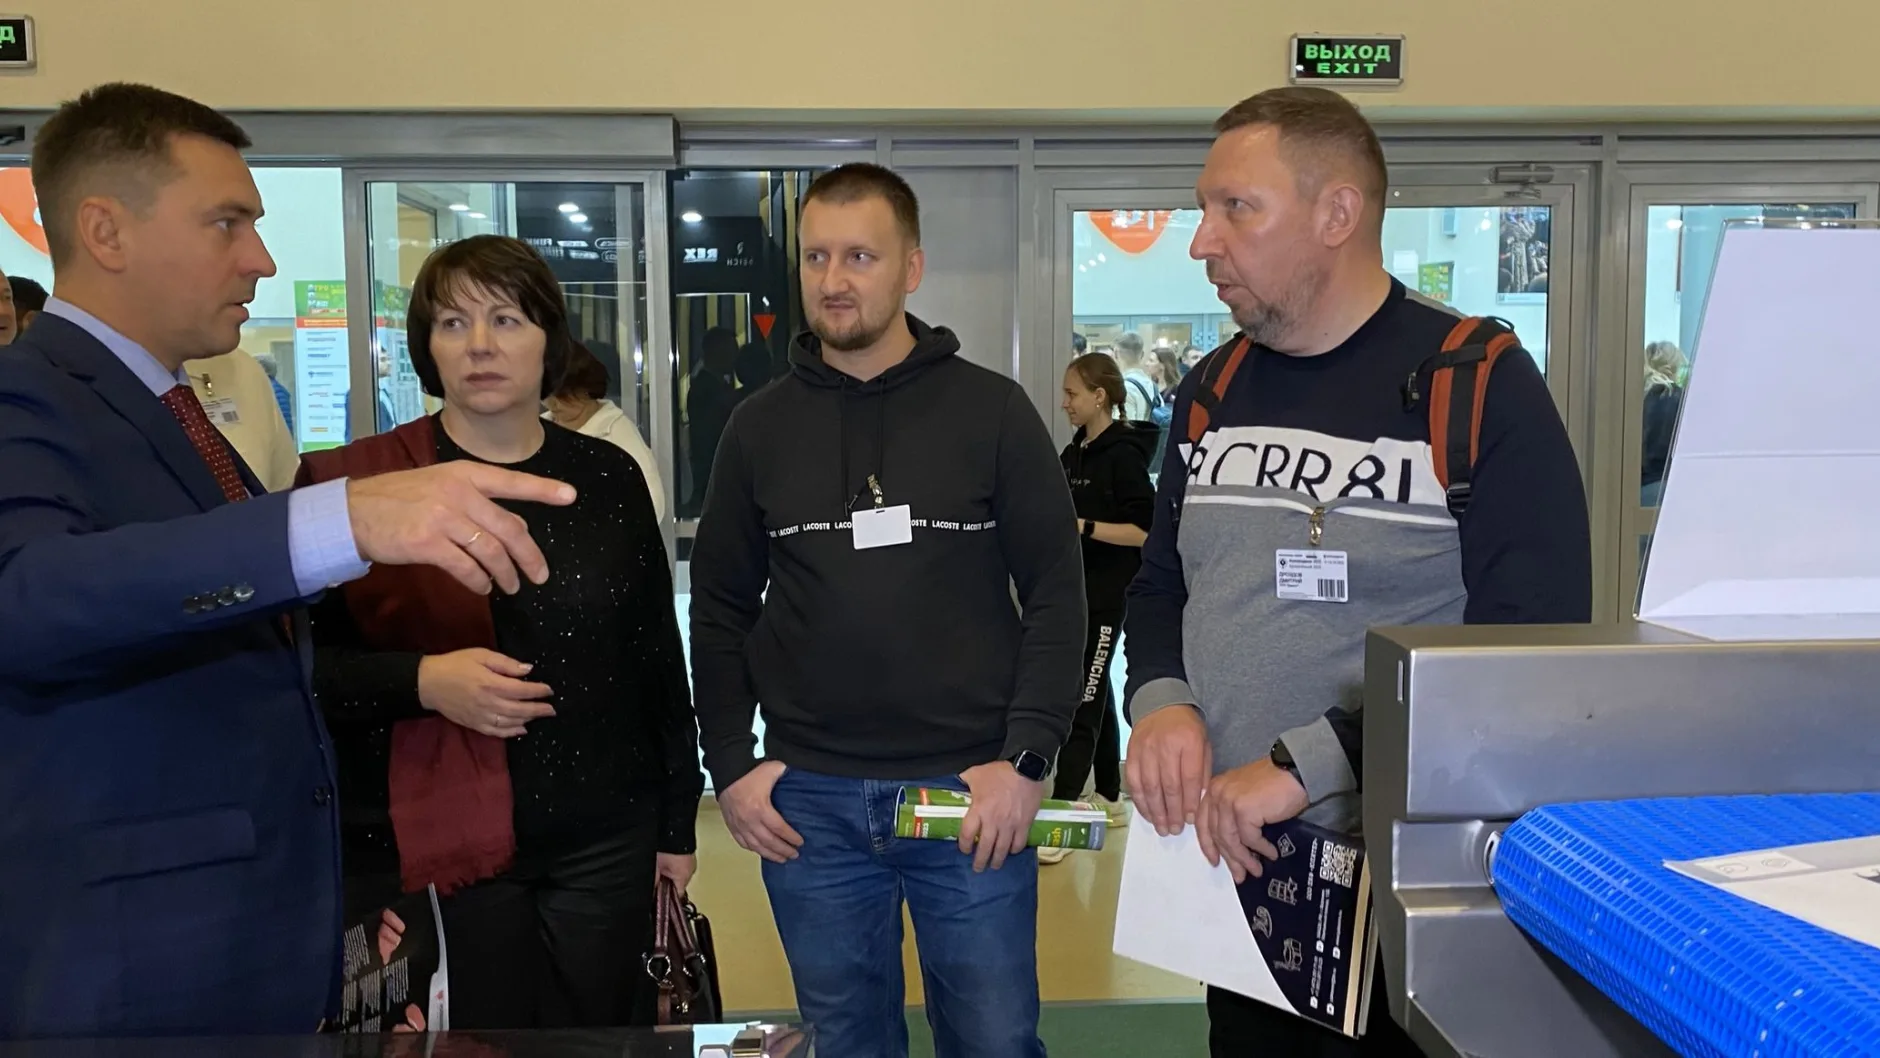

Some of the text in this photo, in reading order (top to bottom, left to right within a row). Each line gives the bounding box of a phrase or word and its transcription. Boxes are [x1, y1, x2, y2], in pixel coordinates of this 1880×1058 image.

[1305, 44, 1391, 62] ВЫХОД
[1317, 63, 1378, 74] EXIT
[778, 525, 799, 537] LACOSTE
[803, 522, 830, 531] LACOSTE
[834, 521, 853, 530] LACO
[910, 519, 927, 527] OSTE
[932, 520, 960, 531] LACOSTE
[1082, 625, 1112, 702] BALENCIAGA
